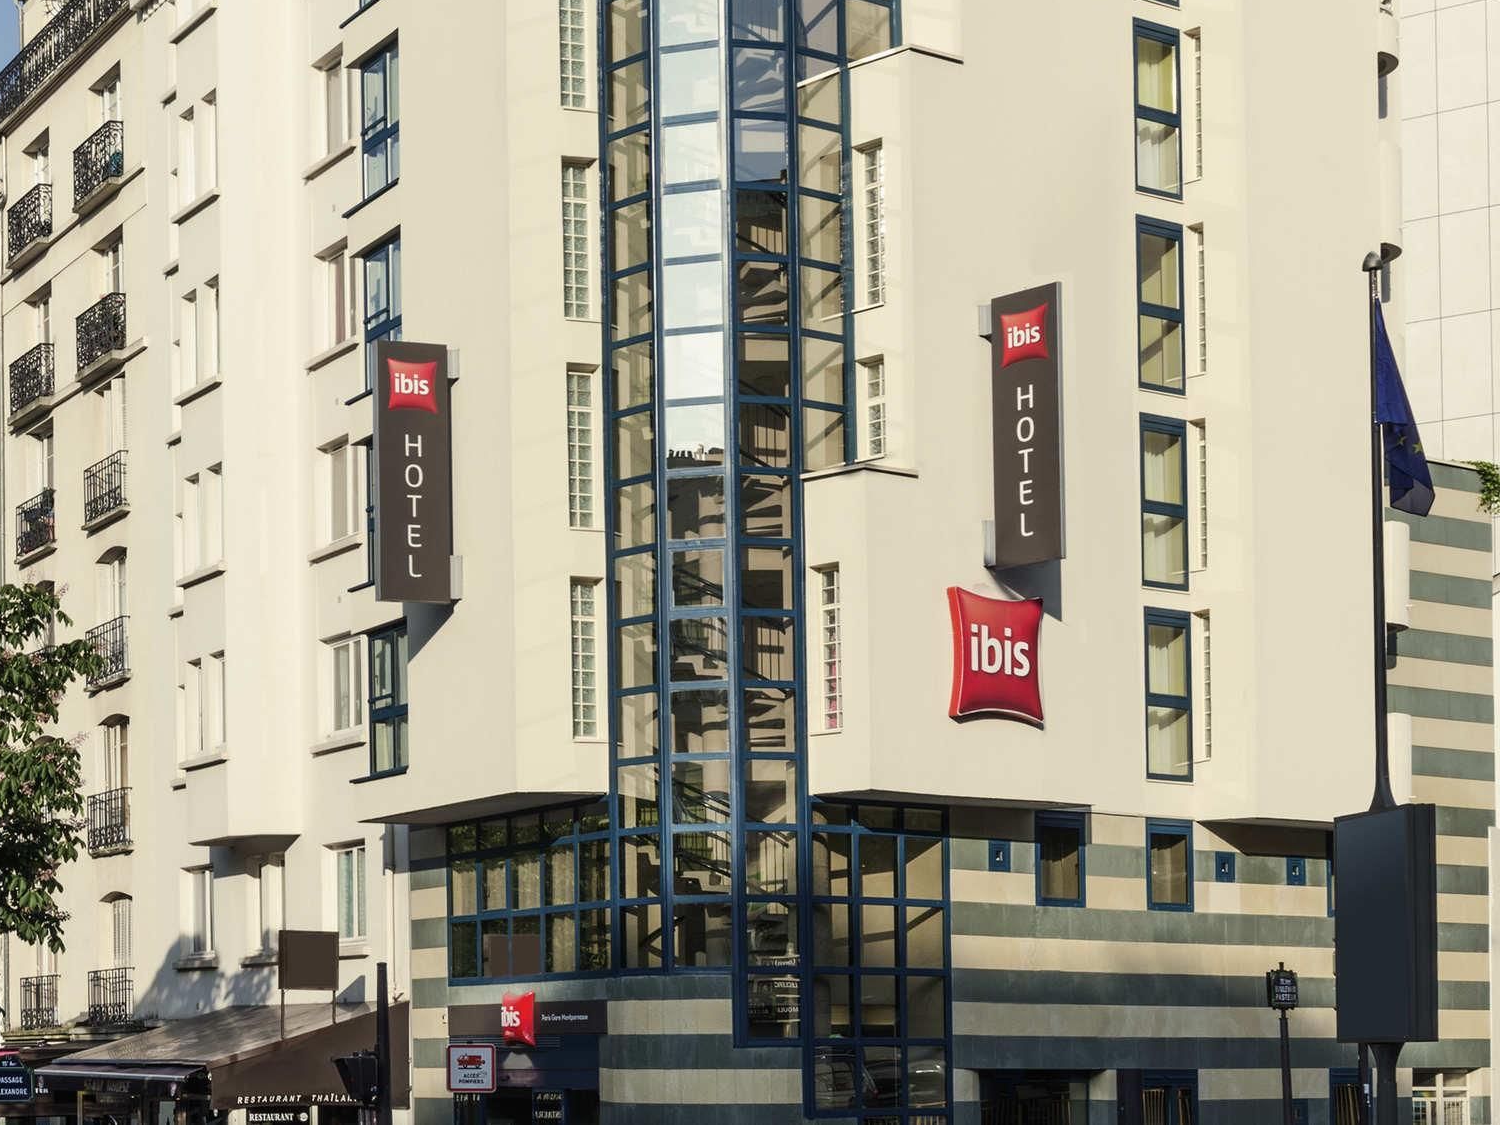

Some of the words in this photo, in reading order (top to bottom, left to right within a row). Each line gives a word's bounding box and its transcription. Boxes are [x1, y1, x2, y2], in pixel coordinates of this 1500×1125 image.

[1007, 322, 1041, 349] ibis
[393, 373, 430, 396] ibis
[1016, 384, 1034, 537] HOTEL
[404, 433, 424, 578] HOTEL
[970, 623, 1031, 678] ibis
[501, 1006, 520, 1027] ibis
[237, 1094, 302, 1105] RESTAURANT
[249, 1113, 294, 1122] RESTAURANT
